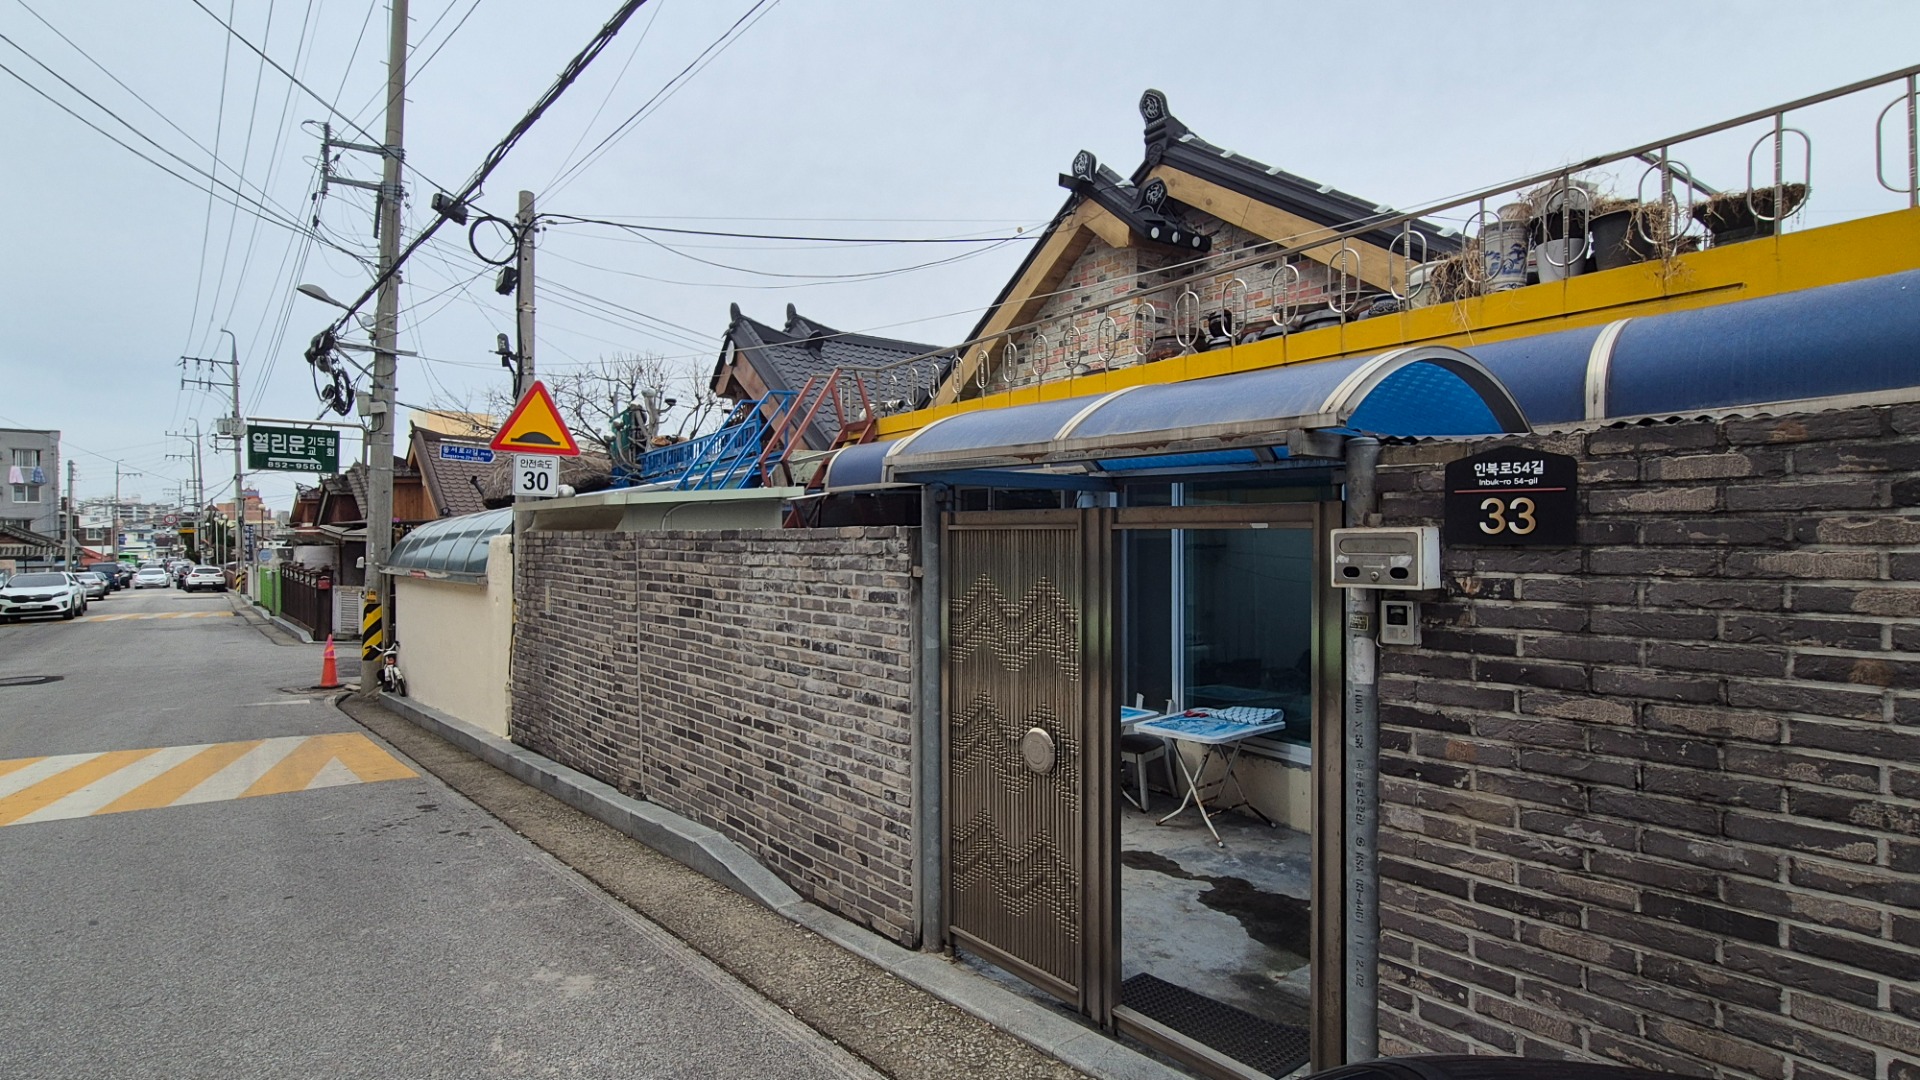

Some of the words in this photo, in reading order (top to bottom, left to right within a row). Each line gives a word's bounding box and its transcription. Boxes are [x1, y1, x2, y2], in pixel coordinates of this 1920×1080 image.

[252, 432, 306, 455] 열린문
[307, 436, 335, 447] 기도원
[267, 461, 323, 470] 852-9550
[520, 459, 553, 469] 안전속도
[1474, 460, 1544, 477] 인북로54길
[523, 471, 549, 491] 30
[1479, 478, 1511, 486] Inbuk-ro
[1514, 477, 1538, 485] 54-gil
[1479, 497, 1537, 535] 33
